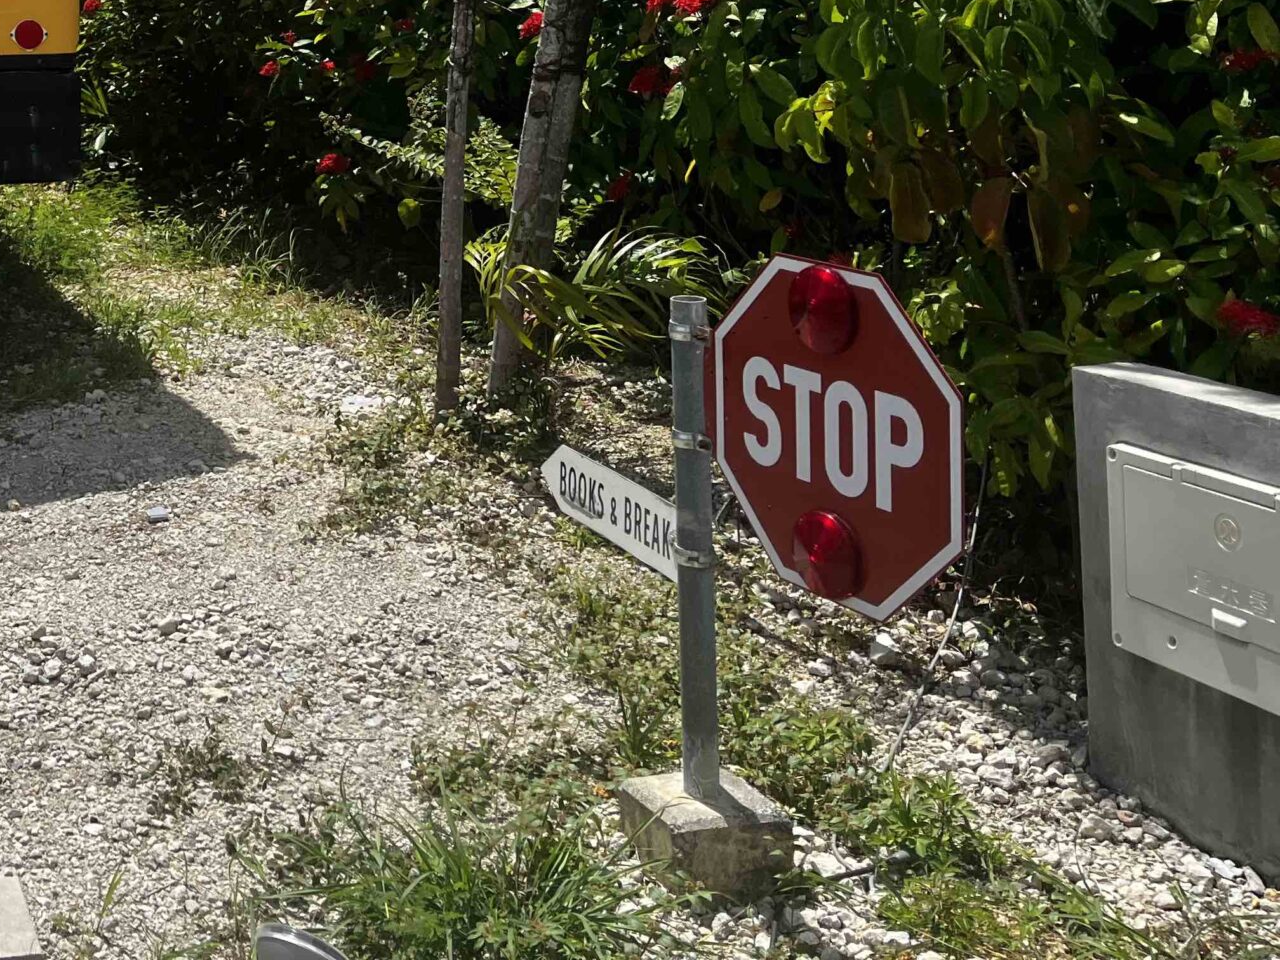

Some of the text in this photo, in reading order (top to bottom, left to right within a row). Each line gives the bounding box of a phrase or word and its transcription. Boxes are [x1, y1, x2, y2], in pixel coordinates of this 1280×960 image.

[742, 355, 925, 513] STOP
[559, 460, 671, 561] BOOKS & BREAK
